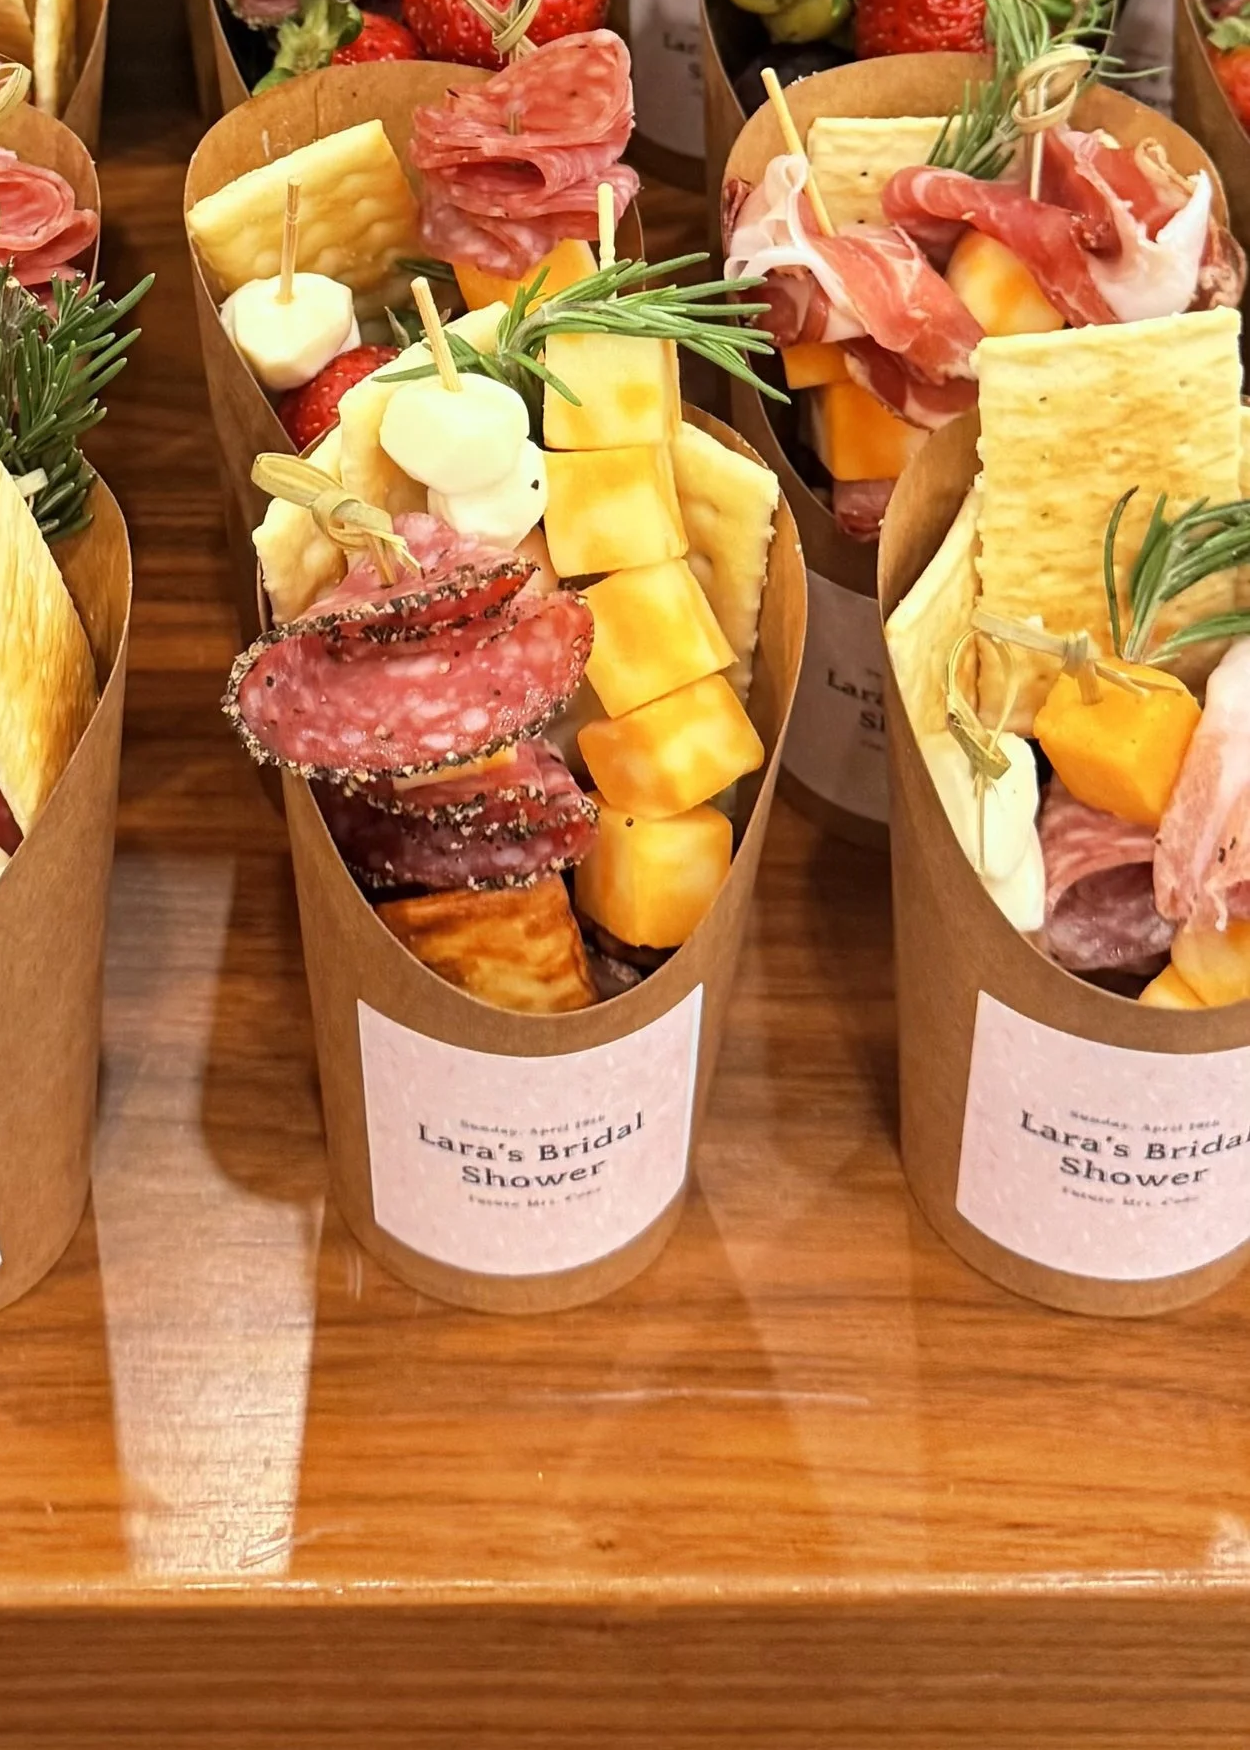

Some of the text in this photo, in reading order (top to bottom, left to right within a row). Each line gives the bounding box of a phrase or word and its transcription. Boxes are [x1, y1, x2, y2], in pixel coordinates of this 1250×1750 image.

[418, 1111, 645, 1163] Lara's Bridal
[1020, 1109, 1131, 1159] Lara's
[461, 1159, 607, 1189] Shower
[1059, 1154, 1210, 1188] Shower
